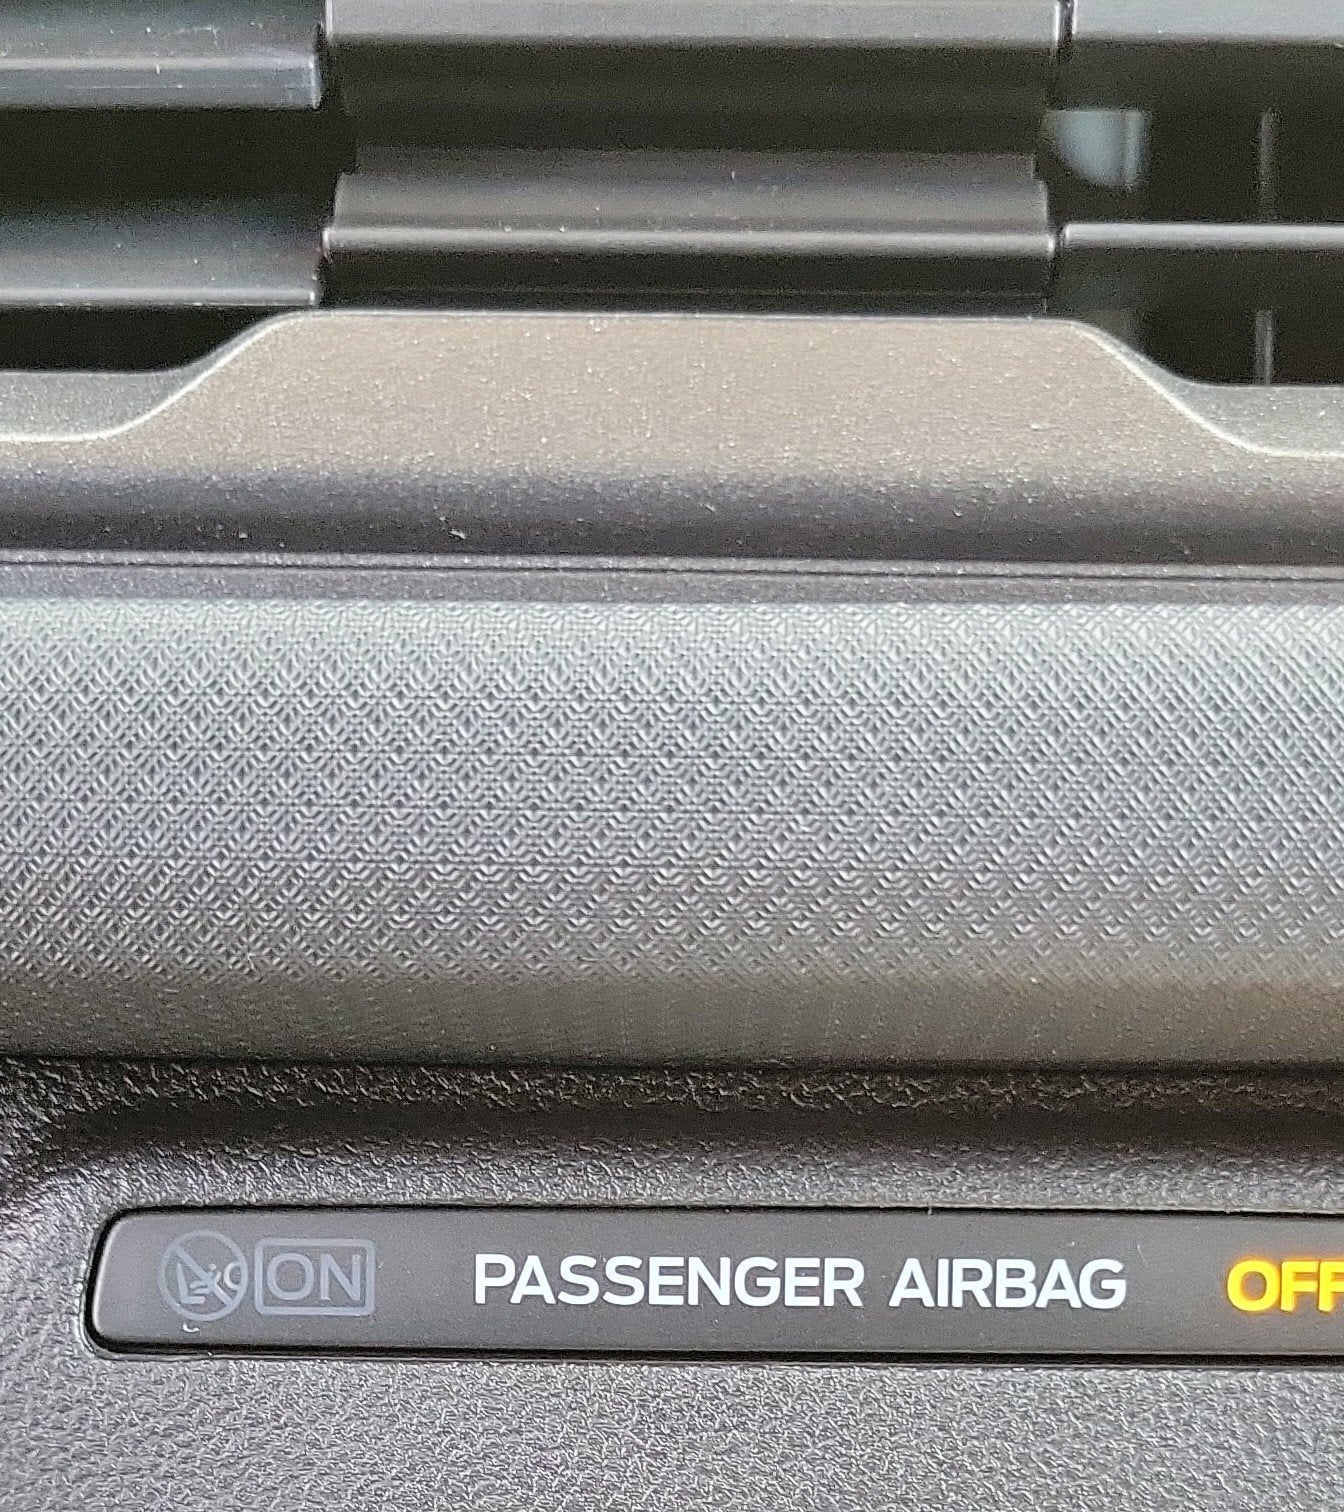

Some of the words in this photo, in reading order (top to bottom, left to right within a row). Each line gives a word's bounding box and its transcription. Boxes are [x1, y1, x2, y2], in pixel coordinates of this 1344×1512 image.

[265, 1251, 363, 1302] ON
[474, 1252, 866, 1307] PASSENGER
[887, 1257, 1127, 1310] AIRBAG
